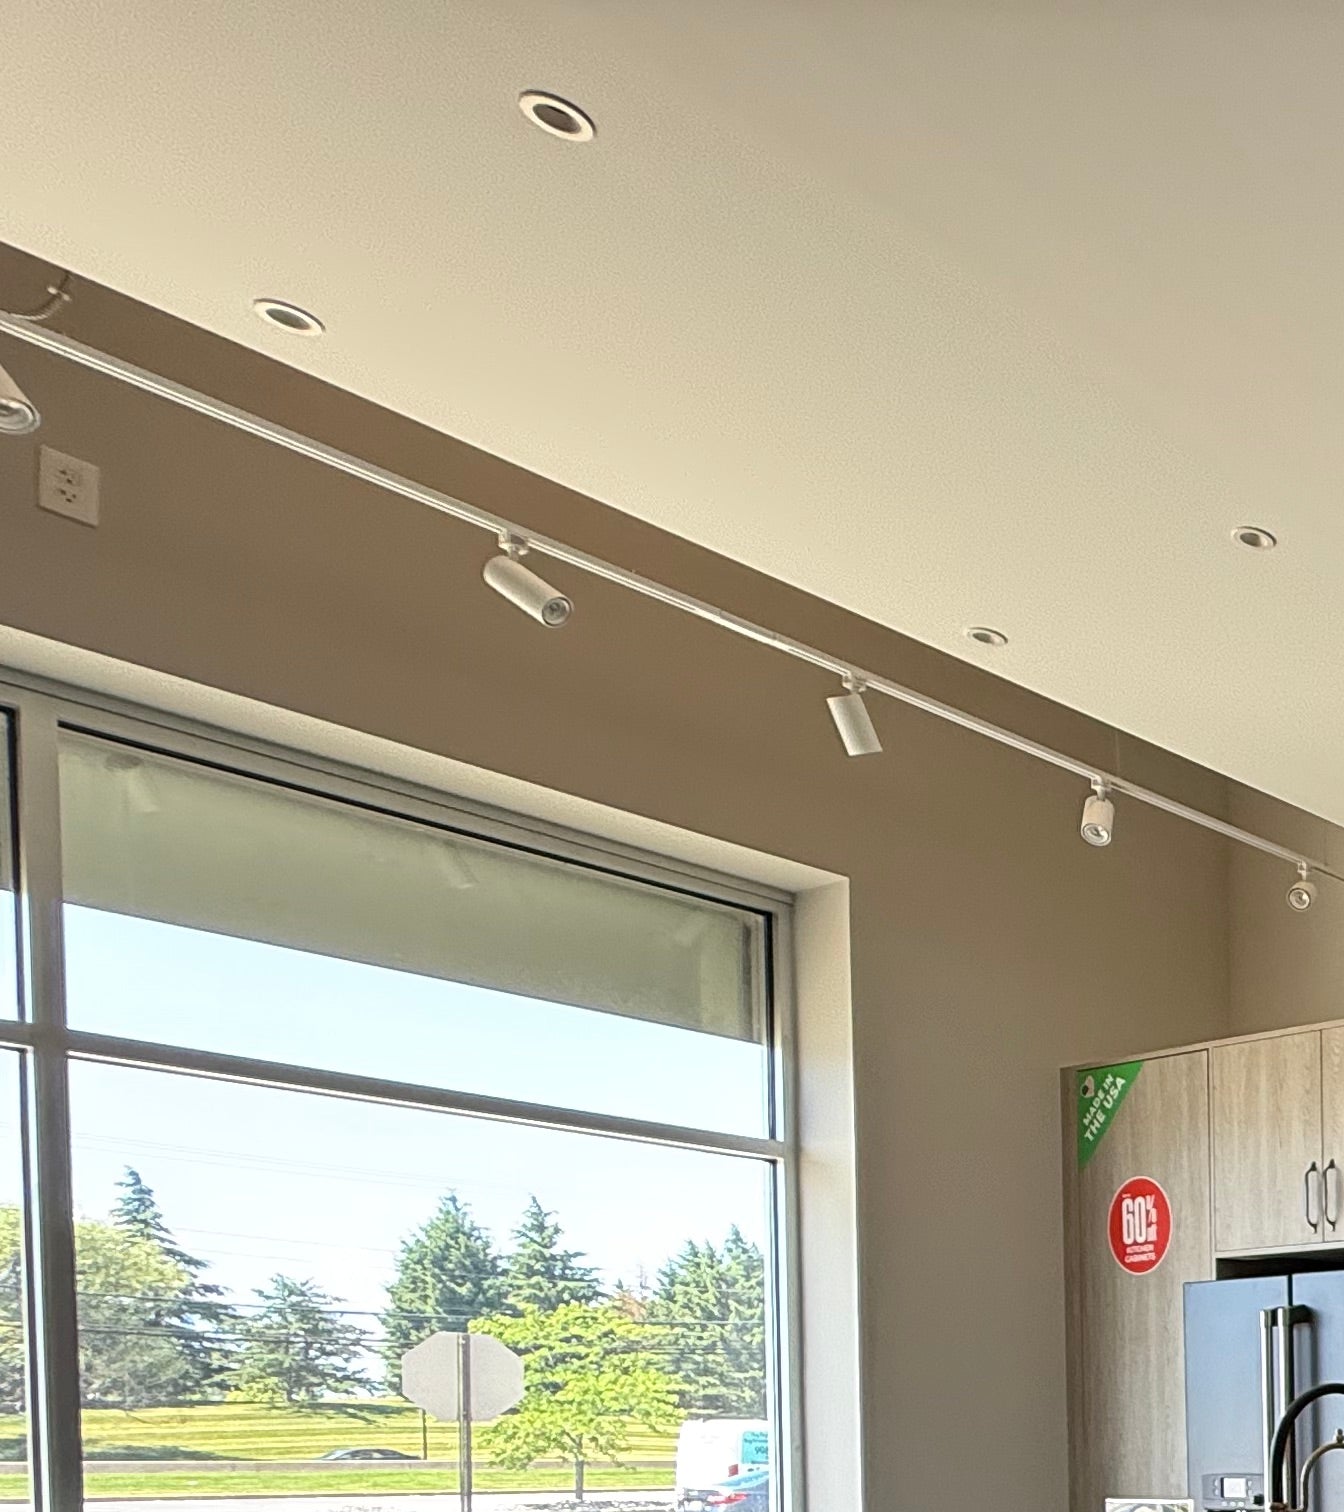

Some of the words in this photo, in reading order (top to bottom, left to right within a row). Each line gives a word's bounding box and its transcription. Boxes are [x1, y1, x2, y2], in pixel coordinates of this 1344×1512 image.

[1082, 1088, 1105, 1127] MADE
[1103, 1073, 1115, 1090] IN
[1084, 1108, 1106, 1142] THE
[1102, 1076, 1127, 1110] USA
[1121, 1194, 1158, 1246] 60%
